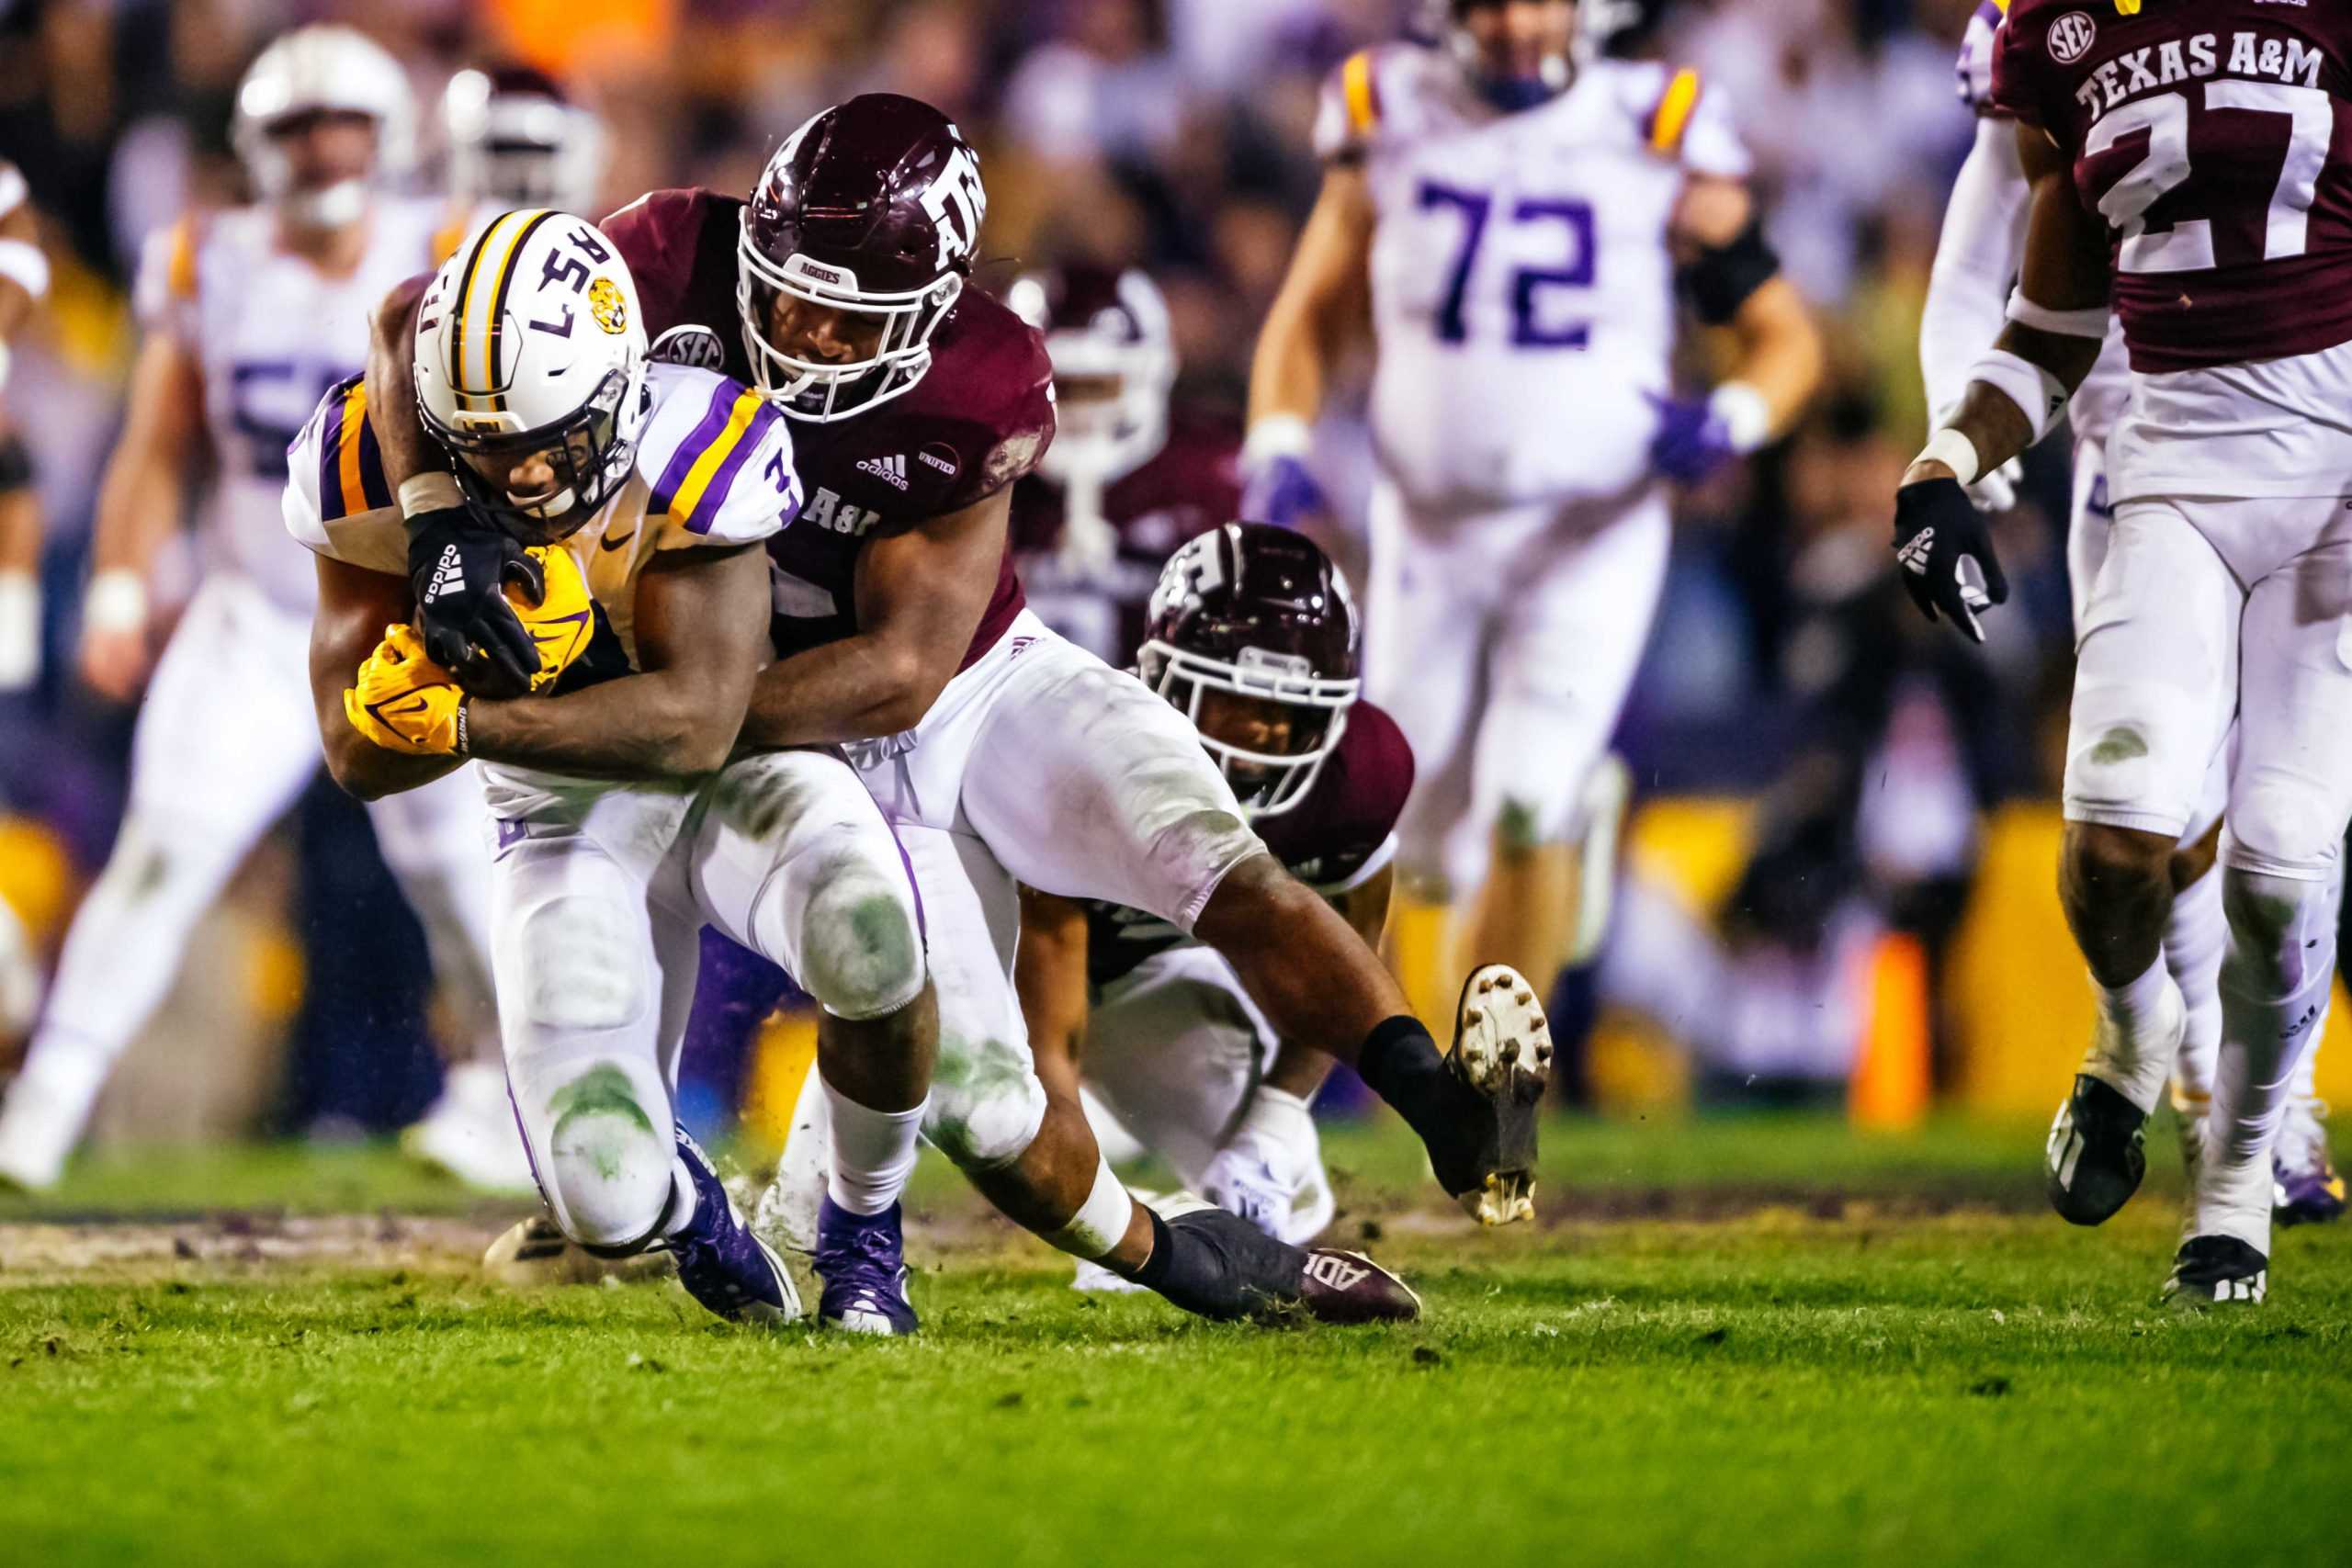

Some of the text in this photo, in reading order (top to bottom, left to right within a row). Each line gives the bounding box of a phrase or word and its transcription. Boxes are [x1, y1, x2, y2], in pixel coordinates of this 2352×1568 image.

[2051, 15, 2091, 58] SEC
[2075, 32, 2324, 121] TEXAS A&M
[2085, 79, 2333, 274] 27
[529, 226, 611, 339] LSU
[799, 263, 840, 285] AGGIES
[1416, 179, 1595, 346] 72
[856, 461, 909, 491] adidas
[919, 451, 956, 475] UNIFIED
[424, 544, 457, 604] adidas
